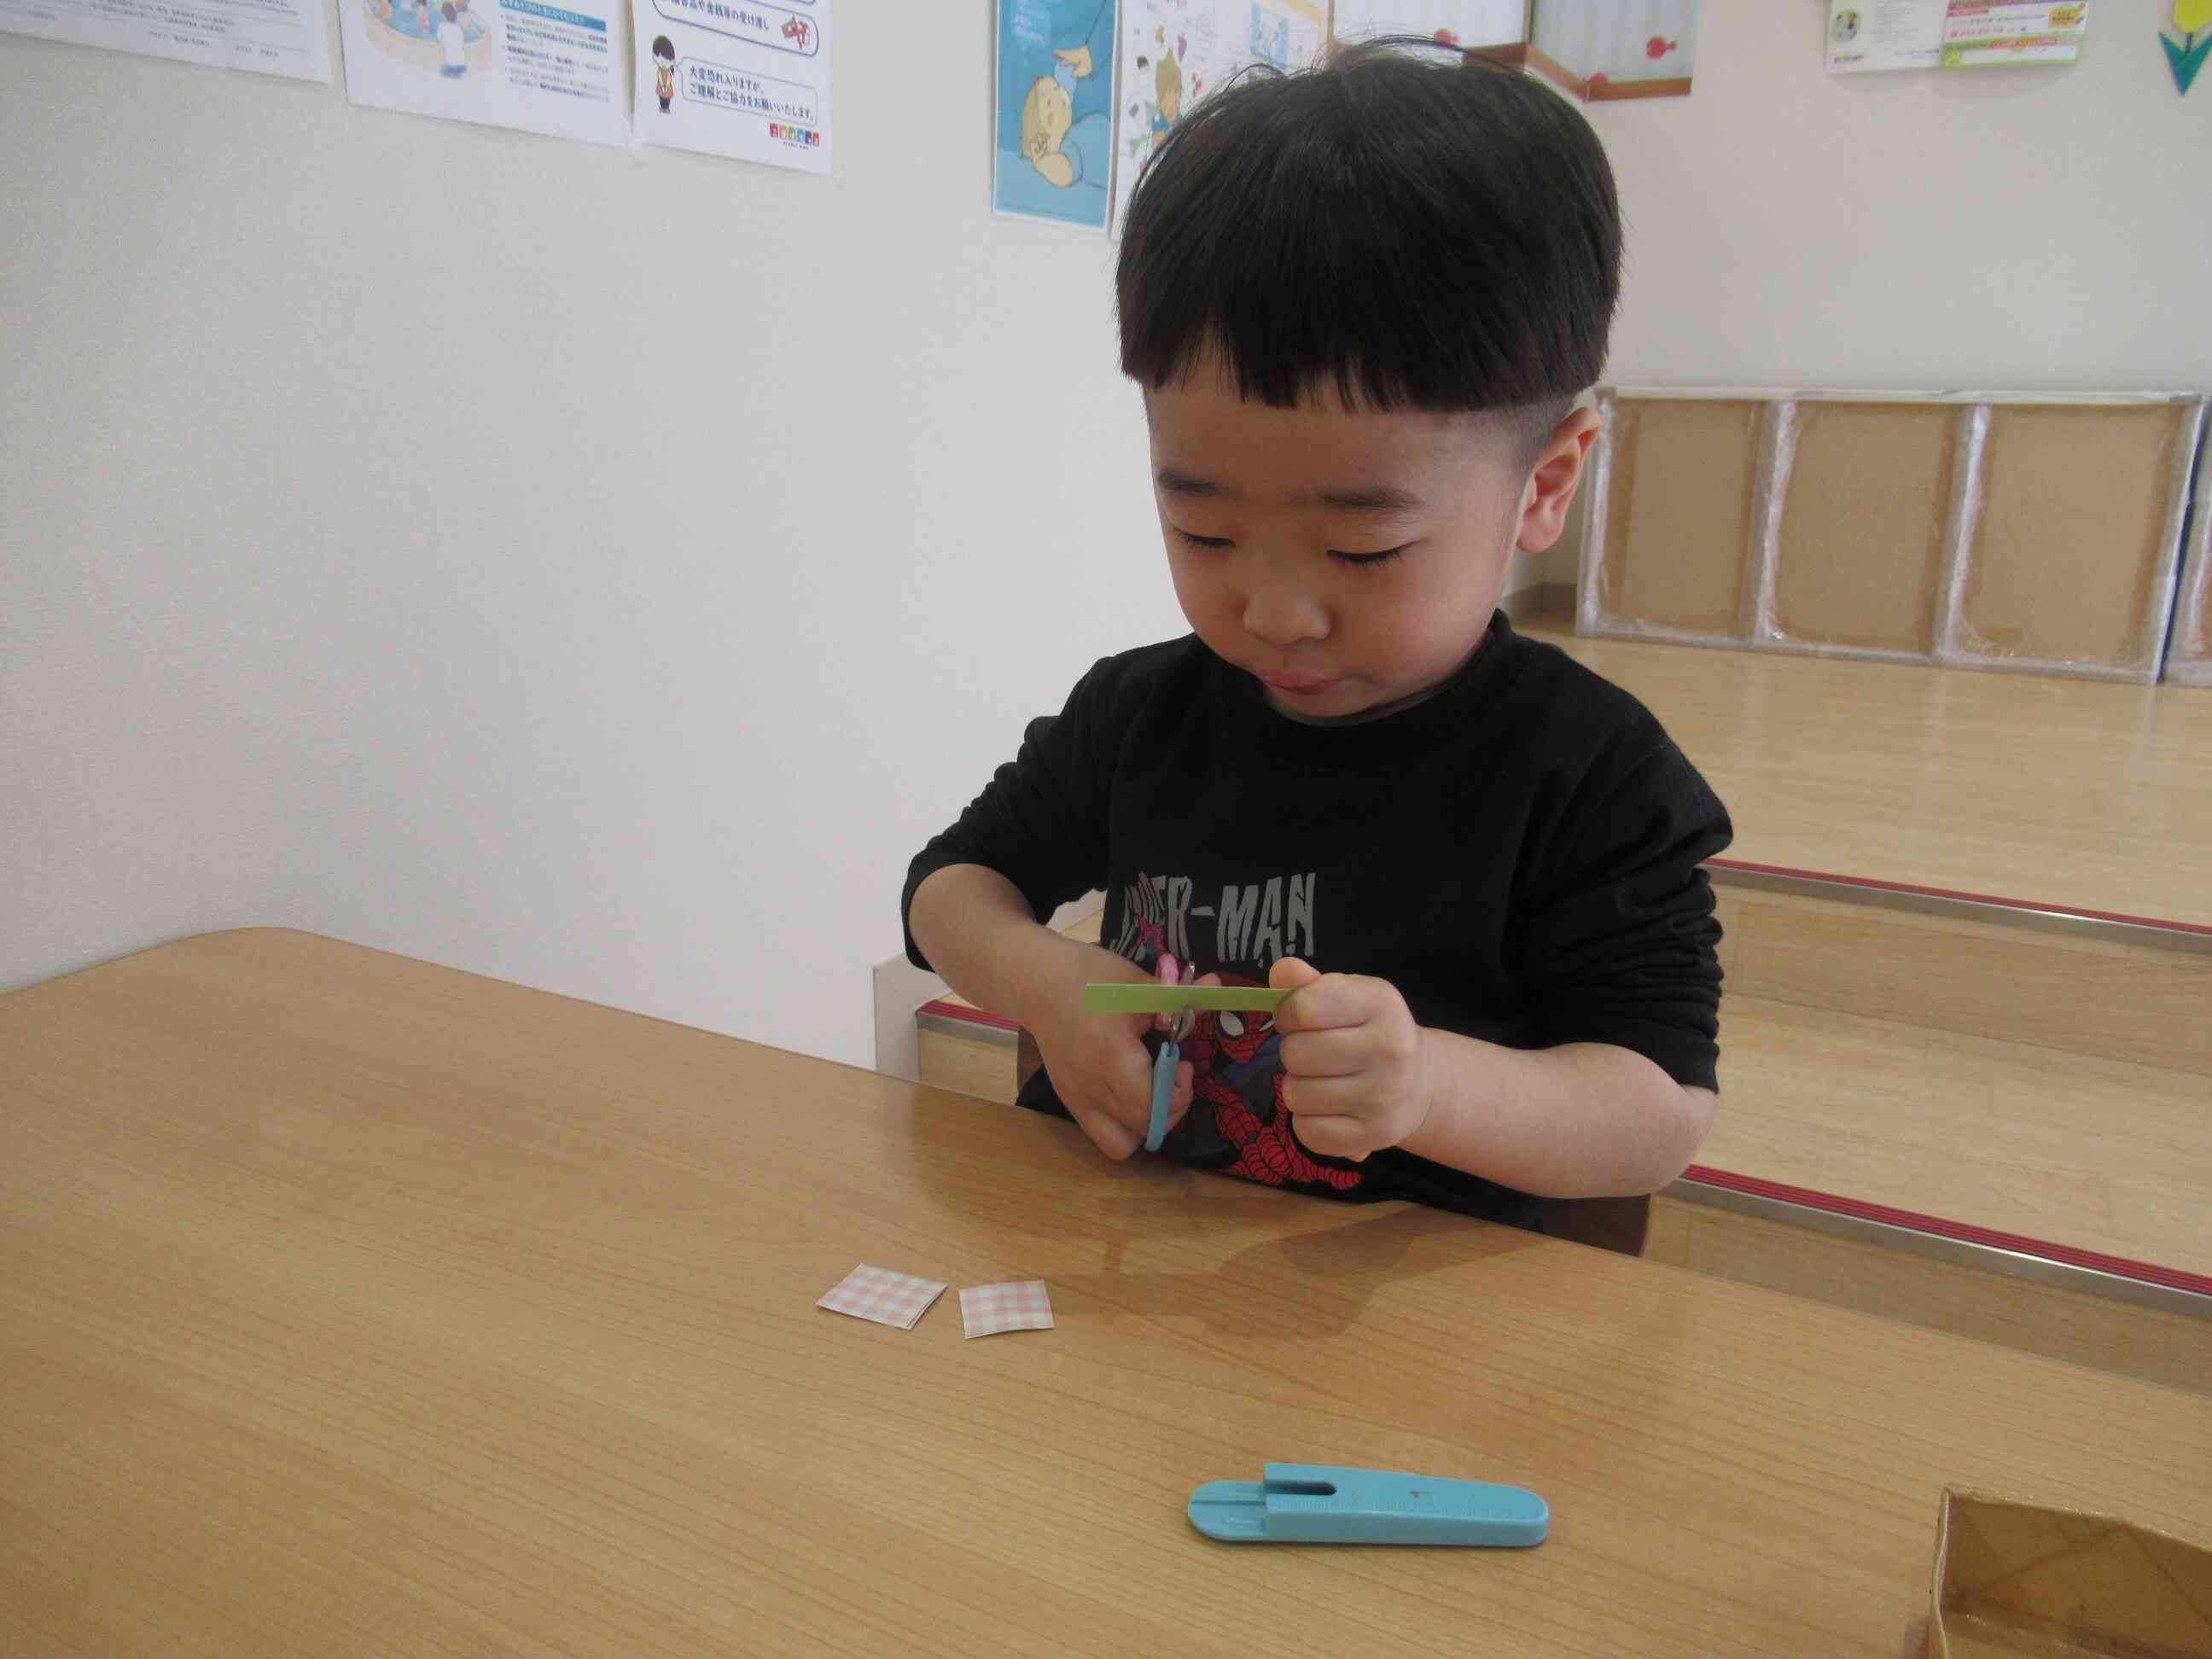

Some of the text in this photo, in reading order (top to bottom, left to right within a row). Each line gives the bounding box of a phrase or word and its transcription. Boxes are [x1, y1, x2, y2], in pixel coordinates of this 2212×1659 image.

[690, 65, 764, 94] 大変恐れ入りますが、
[690, 82, 814, 122] ご理解とご協力をお願いいたします。
